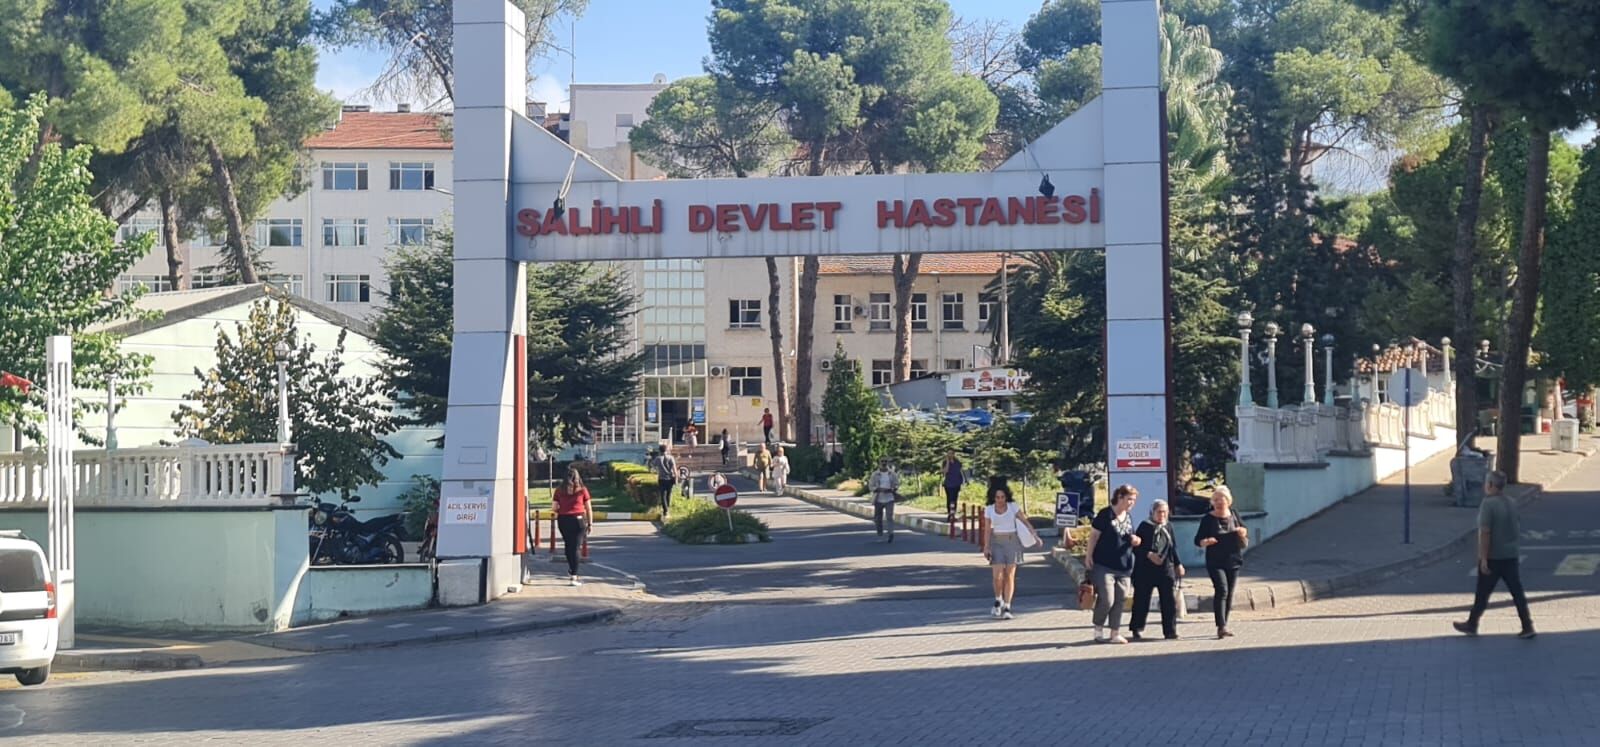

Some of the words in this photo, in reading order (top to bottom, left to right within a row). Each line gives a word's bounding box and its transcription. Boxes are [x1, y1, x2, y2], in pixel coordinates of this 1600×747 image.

[517, 199, 663, 237] SALİHLİ
[688, 202, 842, 233] DEVLET
[876, 188, 1100, 229] HASTANESİ
